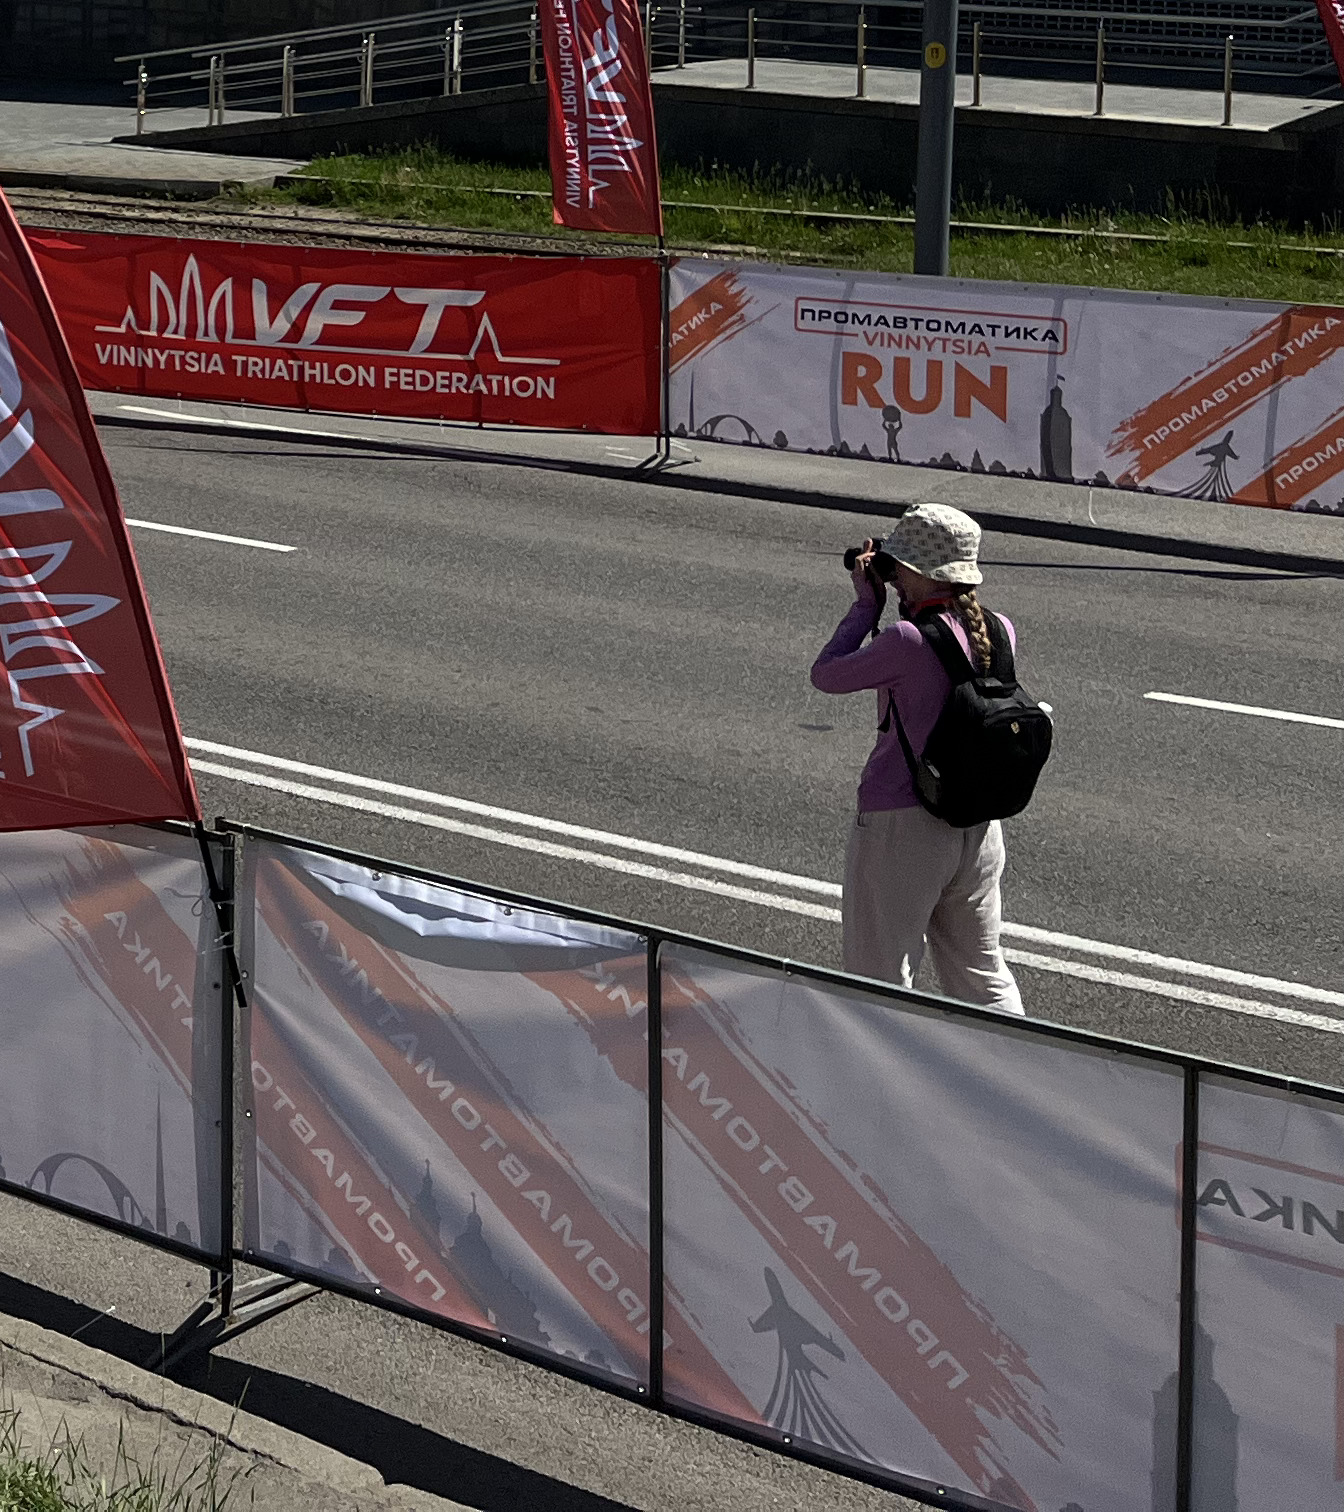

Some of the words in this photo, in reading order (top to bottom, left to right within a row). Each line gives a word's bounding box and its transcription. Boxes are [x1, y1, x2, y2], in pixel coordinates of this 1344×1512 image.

[252, 278, 485, 354] VFT
[800, 308, 1060, 344] ПРОМАВТОМАТИКА
[863, 330, 991, 357] VINNYTSIA
[94, 343, 225, 375] VINNYTSIA
[232, 354, 376, 388] TRIATHLON
[384, 366, 555, 400] FEDERATION
[841, 351, 1008, 424] RUN
[1142, 316, 1341, 450] ПРОМАВТОМАТИКА
